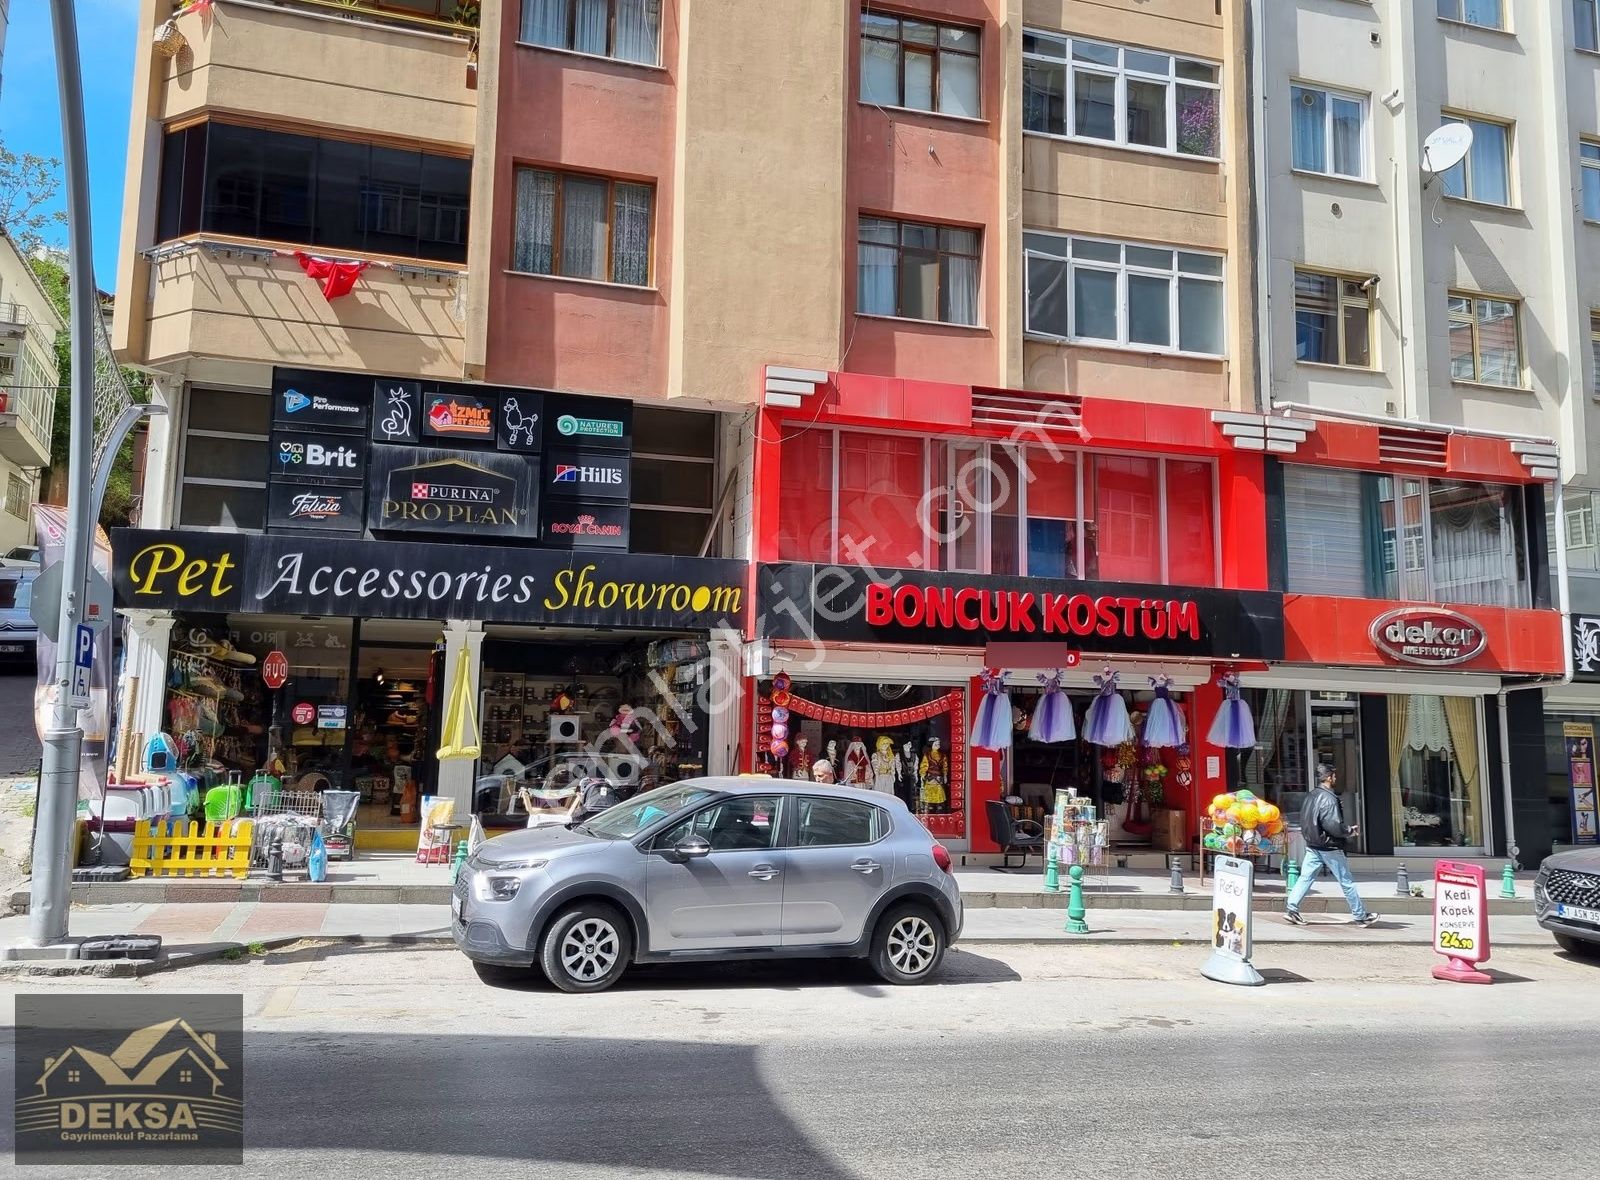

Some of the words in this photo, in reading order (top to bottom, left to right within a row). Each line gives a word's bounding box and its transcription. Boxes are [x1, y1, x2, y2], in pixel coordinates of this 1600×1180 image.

[313, 396, 328, 404] Pro
[313, 403, 360, 413] Performance
[469, 418, 491, 428] SHOP
[306, 444, 357, 468] Brit
[580, 466, 623, 484] Hill's
[430, 487, 490, 501] PURINA
[289, 493, 342, 516] Felicia
[383, 500, 442, 521] PRO
[448, 504, 519, 526] PLAN
[552, 523, 586, 534] ROYAL
[587, 524, 622, 536] CANIN
[129, 543, 236, 597] Pet
[255, 552, 535, 603] Accessories
[544, 564, 742, 613] Showroom
[865, 582, 1036, 633] BONCUK
[1042, 591, 1199, 641] KOSTÜM
[1385, 619, 1475, 645] dekor
[79, 629, 91, 663] P
[1444, 889, 1471, 900] Kedi
[1440, 921, 1476, 929] KONSERVE
